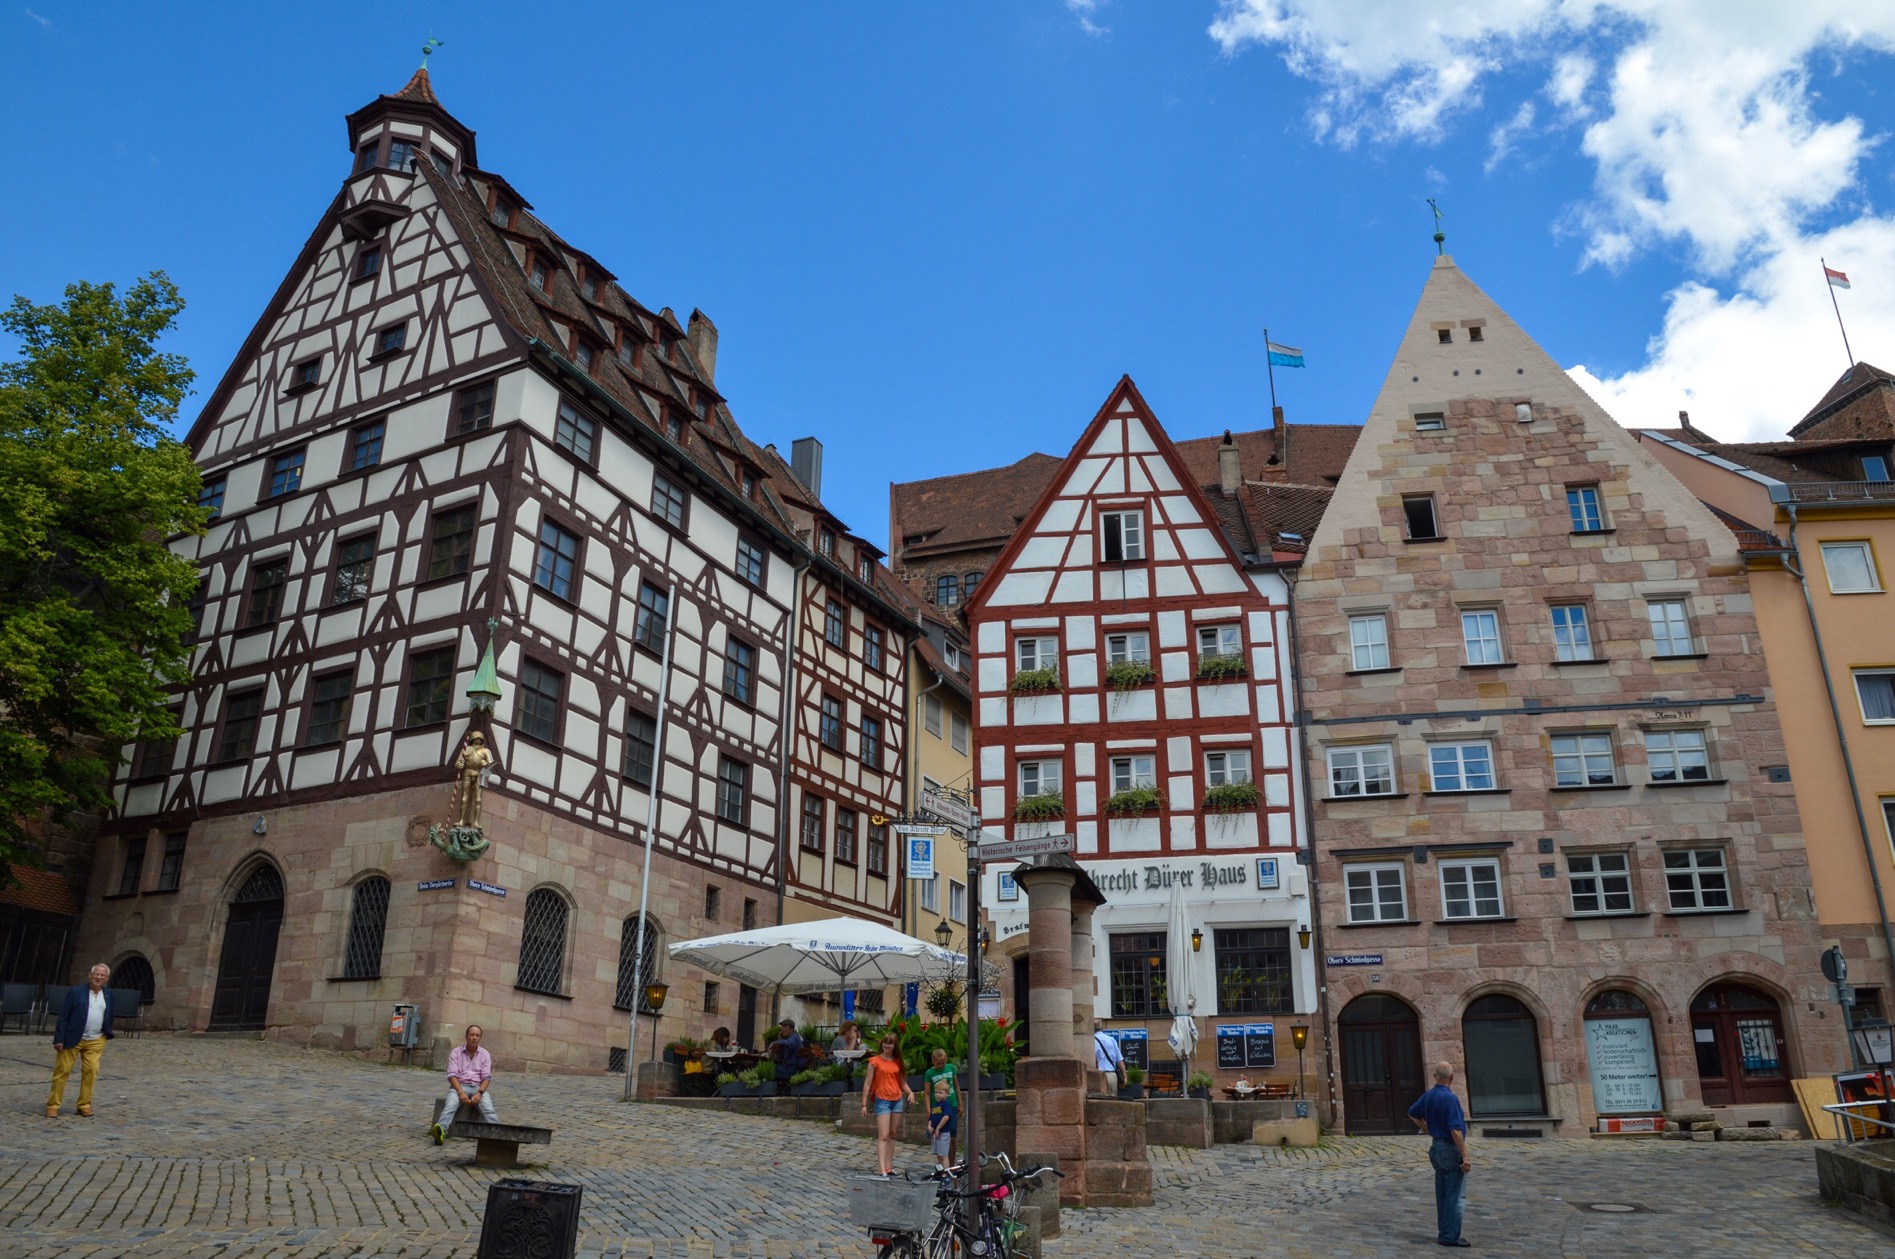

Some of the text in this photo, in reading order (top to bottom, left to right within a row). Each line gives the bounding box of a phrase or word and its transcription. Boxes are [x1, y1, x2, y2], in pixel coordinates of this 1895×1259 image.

[1655, 711, 1677, 719] Amos
[982, 842, 1051, 856] Historische Felsengänge
[1144, 864, 1194, 890] Dürer
[1200, 862, 1247, 890] Haus
[1328, 955, 1381, 964] Obere Schmiedgasse
